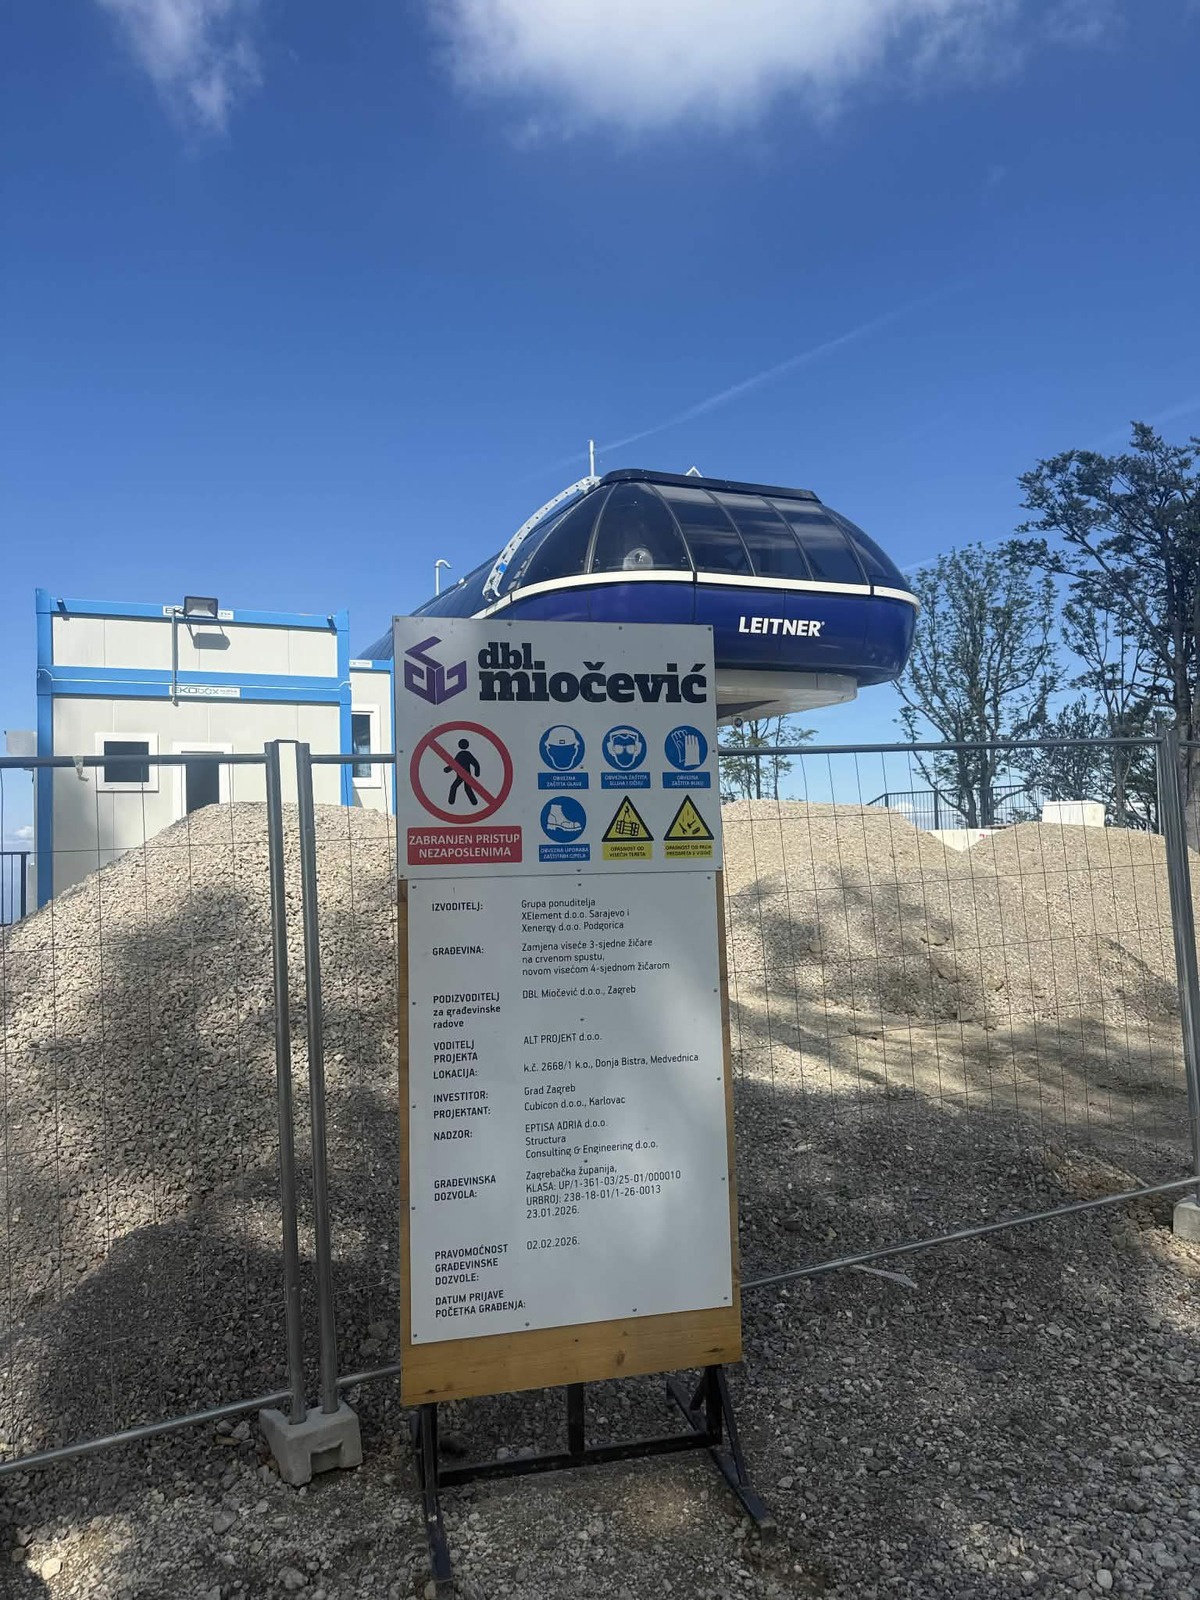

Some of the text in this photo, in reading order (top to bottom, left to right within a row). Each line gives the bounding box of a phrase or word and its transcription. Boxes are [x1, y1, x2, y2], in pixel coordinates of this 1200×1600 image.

[739, 616, 821, 637] LEITNER
[479, 662, 707, 703] miočević
[409, 834, 520, 846] ZABRANJEN PRISTUP
[419, 846, 511, 858] NEZAPOSLENIMA
[432, 902, 483, 911] IZVODITELJ:
[521, 898, 596, 910] Grupa ponuditelja
[521, 910, 562, 920] XElement
[564, 910, 587, 919] d.o.o.
[589, 909, 625, 919] Sarajevo
[522, 921, 624, 934] Xenergy d.o.o. Podgorica
[432, 946, 484, 956] GRAĐEVINA:
[522, 937, 653, 952] Zamjena viseće 3-sjedne žičare
[522, 953, 605, 963] na crvenom spustu,
[522, 960, 670, 976] novom visećom 4-sjednom žičarom
[433, 992, 500, 1004] PODIZVODITELJ
[522, 989, 539, 999] DBL
[541, 986, 578, 998] Miočević
[607, 984, 636, 996] Zagreb
[433, 1004, 501, 1017] za građevinske
[433, 1019, 464, 1029] radove
[523, 1032, 602, 1045] ALT PROJEKT d.o.o.
[434, 1040, 475, 1051] VODITELJ
[434, 1052, 478, 1063] PROJEKTA
[524, 1052, 699, 1073] k.č. 2668/1 k.o., Donja Bistra, Medvednica
[433, 1068, 478, 1079] LOKACIJA:
[524, 1083, 576, 1096] Grad Zagreb
[433, 1091, 488, 1103] INVESTITOR:
[524, 1099, 559, 1112] Cubicon
[589, 1096, 626, 1107] Karlovac
[434, 1106, 491, 1119] PROJEKTANT:
[525, 1118, 608, 1133] EPTISA ADRIA d.o.o.
[434, 1129, 473, 1141] NADZOR:
[525, 1134, 566, 1146] Structura
[525, 1139, 658, 1159] Consulting & Engineering d.o.o.
[526, 1164, 617, 1181] Zagrebačka županija,
[434, 1175, 496, 1189] GRAĐEVINSKA
[526, 1182, 556, 1193] KLASA:
[434, 1189, 478, 1201] DOZVOLA:
[526, 1195, 562, 1206] URBROJ:
[526, 1206, 580, 1219] 23.01.2026.
[526, 1236, 580, 1250] 02.02.2026.
[435, 1243, 508, 1260] PRAVOMOĆNOST
[435, 1258, 499, 1273] GRAĐEVINSKE
[435, 1273, 479, 1286] DOZVOLE:
[435, 1289, 504, 1306] DATUM PRIJAVE
[435, 1300, 526, 1318] POČETKA GRAĐENJA:
